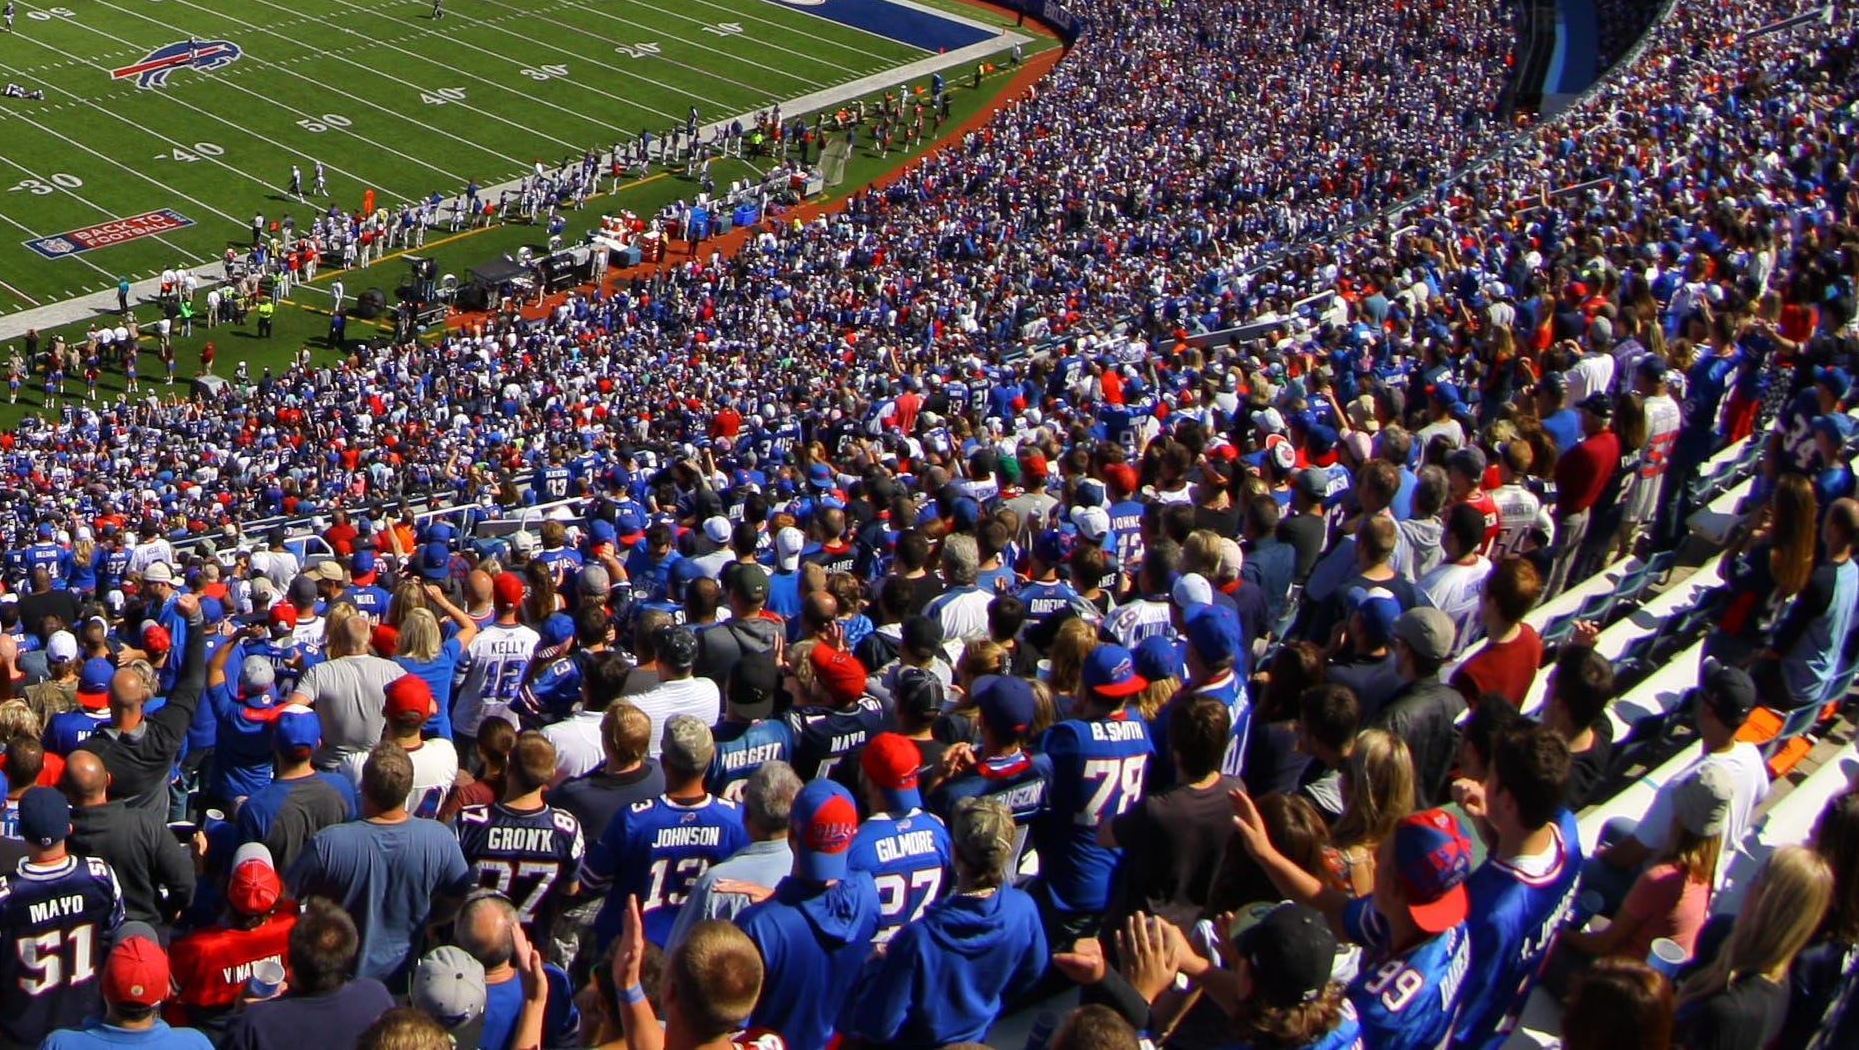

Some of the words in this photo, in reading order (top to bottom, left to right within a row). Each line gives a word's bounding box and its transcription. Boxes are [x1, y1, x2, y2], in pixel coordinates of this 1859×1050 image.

[1043, 1, 1071, 30] BILLS
[702, 21, 745, 38] 10
[614, 42, 655, 60] 20
[518, 64, 563, 81] 30
[417, 86, 461, 107] 40
[294, 112, 354, 134] 50
[167, 140, 226, 164] 40
[18, 171, 84, 197] 30
[74, 221, 135, 240] BACK
[134, 213, 165, 227] TO
[86, 221, 177, 247] FOOTBALL
[491, 640, 527, 656] KELLY
[483, 658, 521, 703] 12
[830, 730, 866, 754] MAYO
[1091, 720, 1144, 743] B.SMITH
[1075, 754, 1149, 827] 78
[488, 826, 554, 854] GRONK
[652, 825, 721, 849] JOHNSON
[875, 829, 936, 864] GILMORE
[29, 893, 85, 925] MAYO
[14, 922, 99, 997] 51
[1364, 959, 1424, 1014] 99
